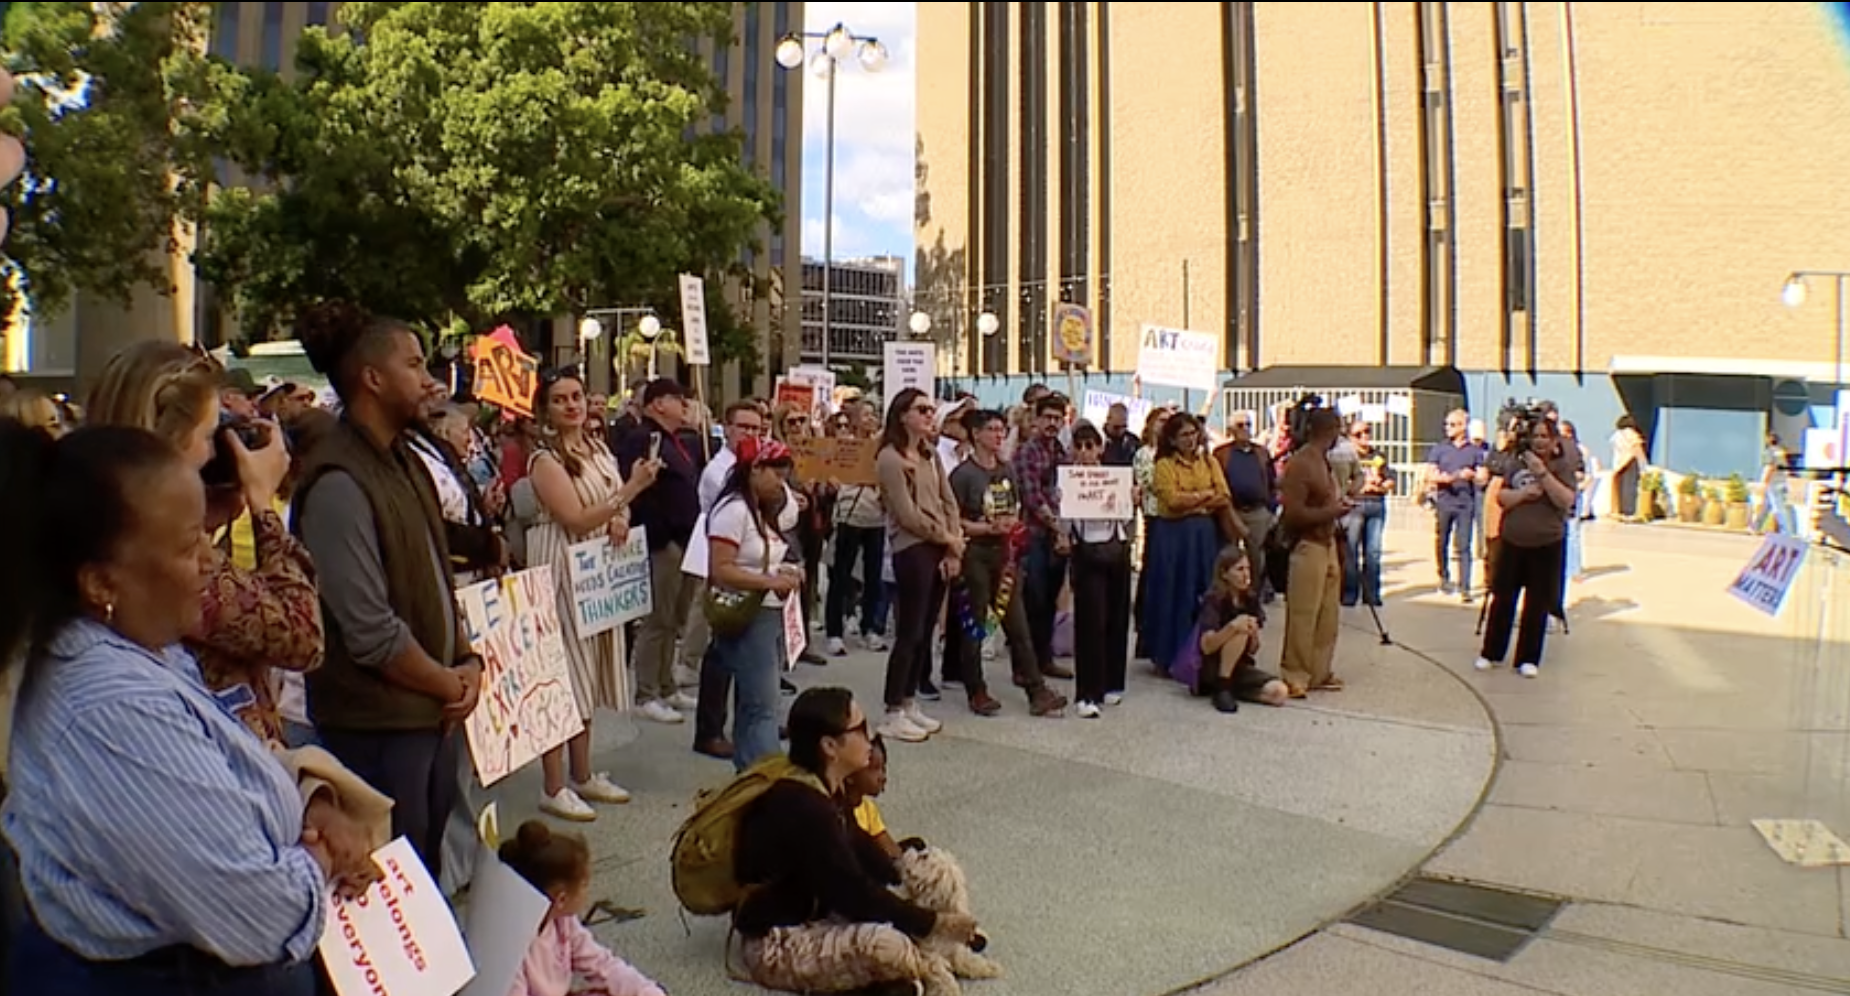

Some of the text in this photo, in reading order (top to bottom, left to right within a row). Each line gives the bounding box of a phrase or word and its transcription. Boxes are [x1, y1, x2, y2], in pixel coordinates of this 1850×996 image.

[1144, 328, 1180, 351] ART
[478, 344, 537, 400] ART
[575, 573, 606, 593] NEEDS
[1752, 543, 1799, 582] ART
[462, 577, 518, 642] LET
[578, 581, 648, 624] THINKERS
[1733, 572, 1782, 609] MATTERS
[472, 613, 531, 692] ANCE
[386, 857, 414, 895] art
[376, 878, 427, 971] elongs
